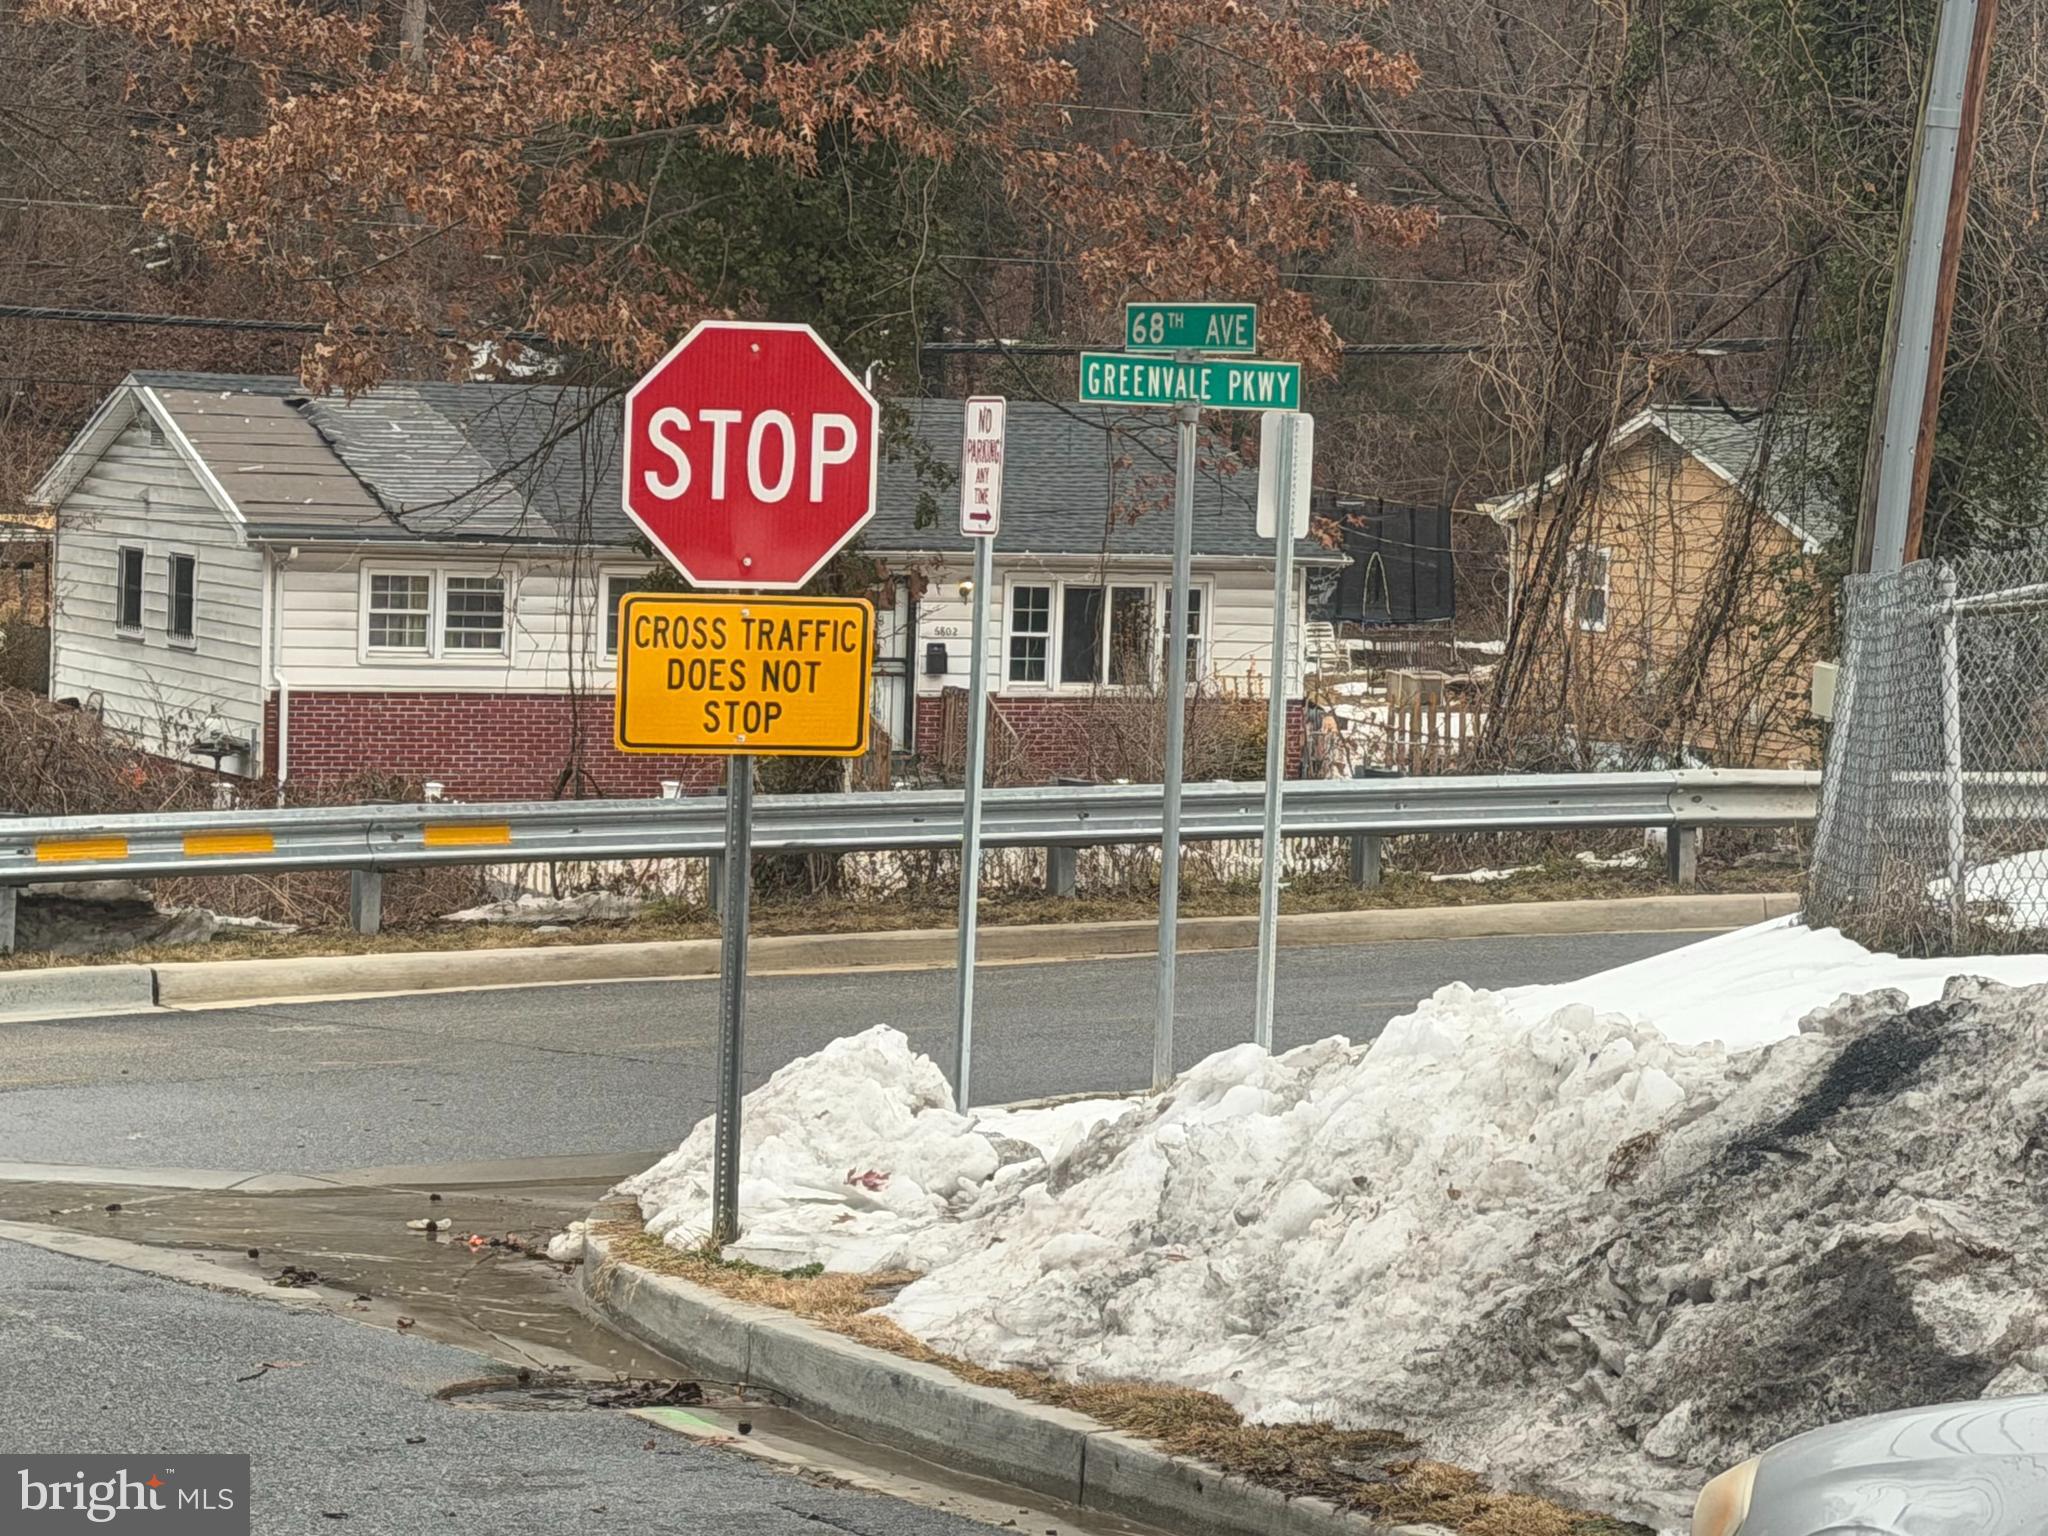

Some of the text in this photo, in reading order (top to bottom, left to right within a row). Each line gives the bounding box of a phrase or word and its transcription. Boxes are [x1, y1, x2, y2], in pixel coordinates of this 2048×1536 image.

[1132, 312, 1248, 345] 68TH AVE
[1088, 362, 1292, 403] GREENVALE PKWY
[979, 407, 993, 434] NO
[644, 407, 858, 503] STOP
[967, 438, 1001, 464] PARKING
[975, 468, 990, 485] ANY
[635, 616, 857, 653] CROSS TRAFFIC
[667, 658, 821, 693] DOES NOT
[703, 701, 783, 734] STOP
